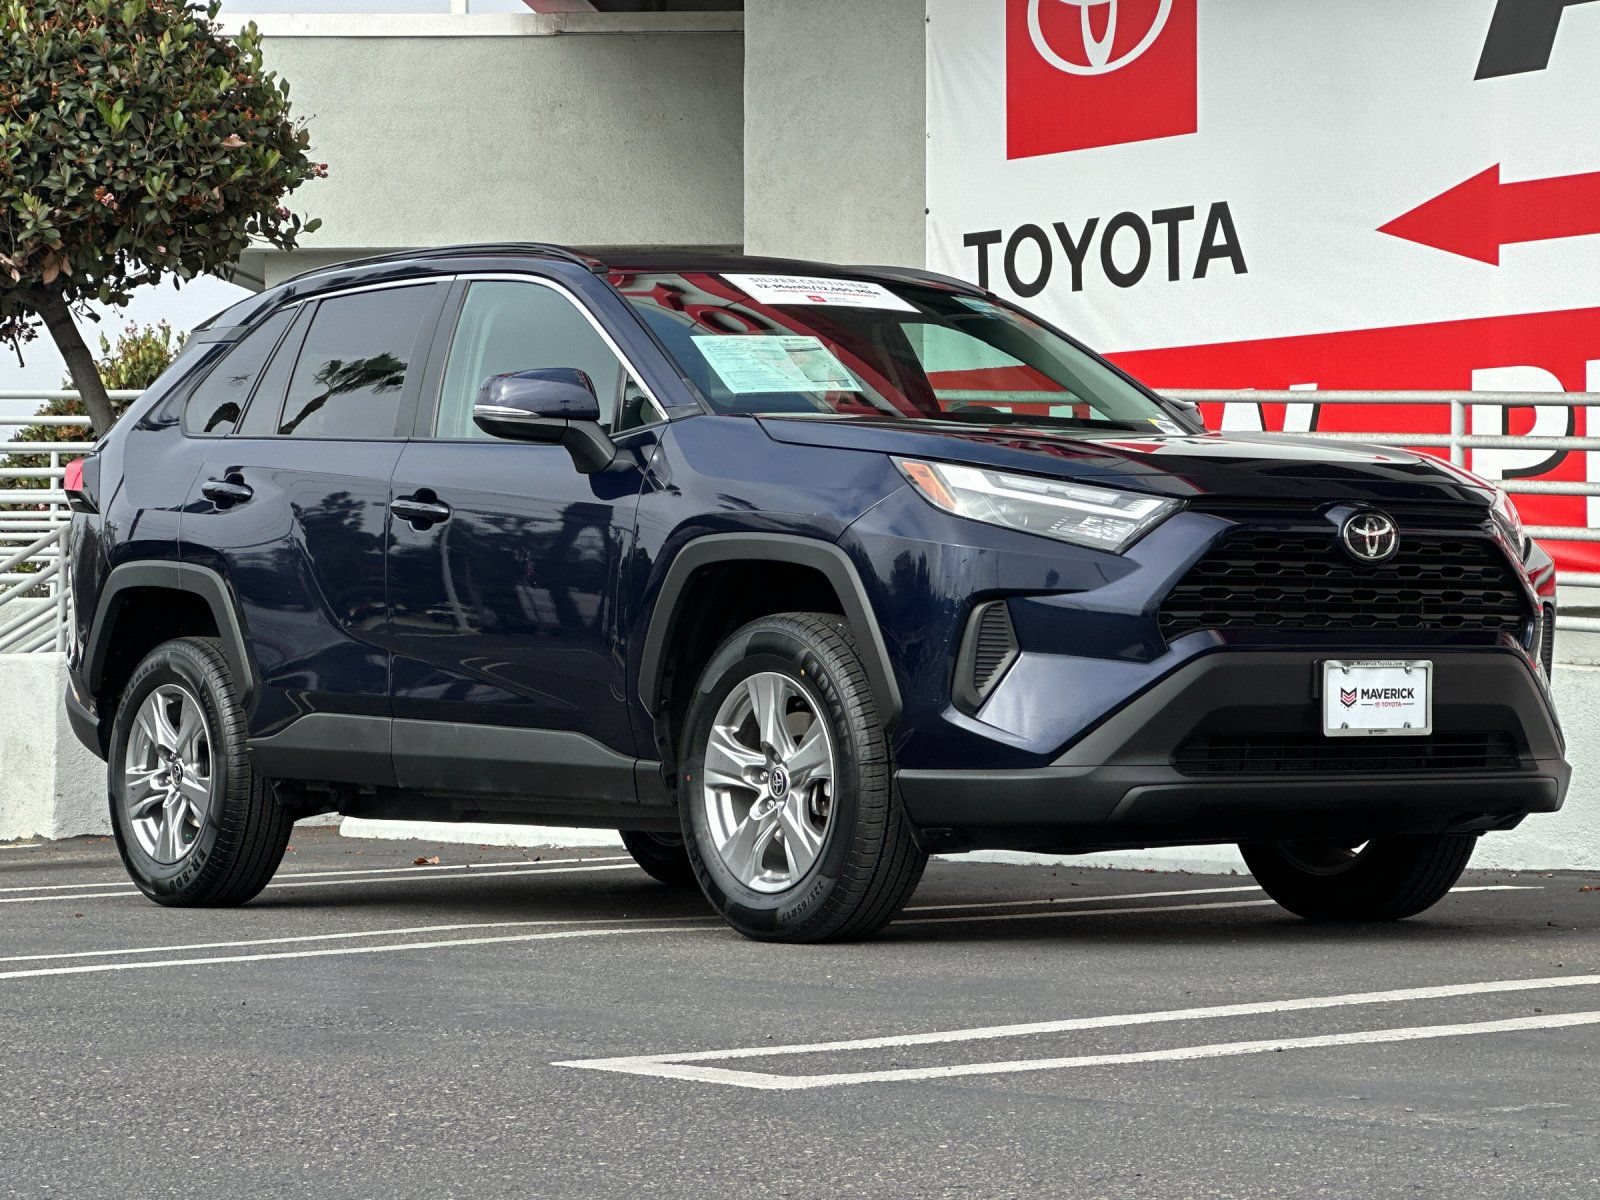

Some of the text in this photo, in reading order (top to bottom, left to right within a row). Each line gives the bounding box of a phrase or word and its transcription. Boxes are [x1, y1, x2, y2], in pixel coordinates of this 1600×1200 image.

[963, 200, 1248, 298] TOYOTA
[1361, 688, 1414, 699] MAVERICK
[782, 881, 824, 922] 225/65R17
